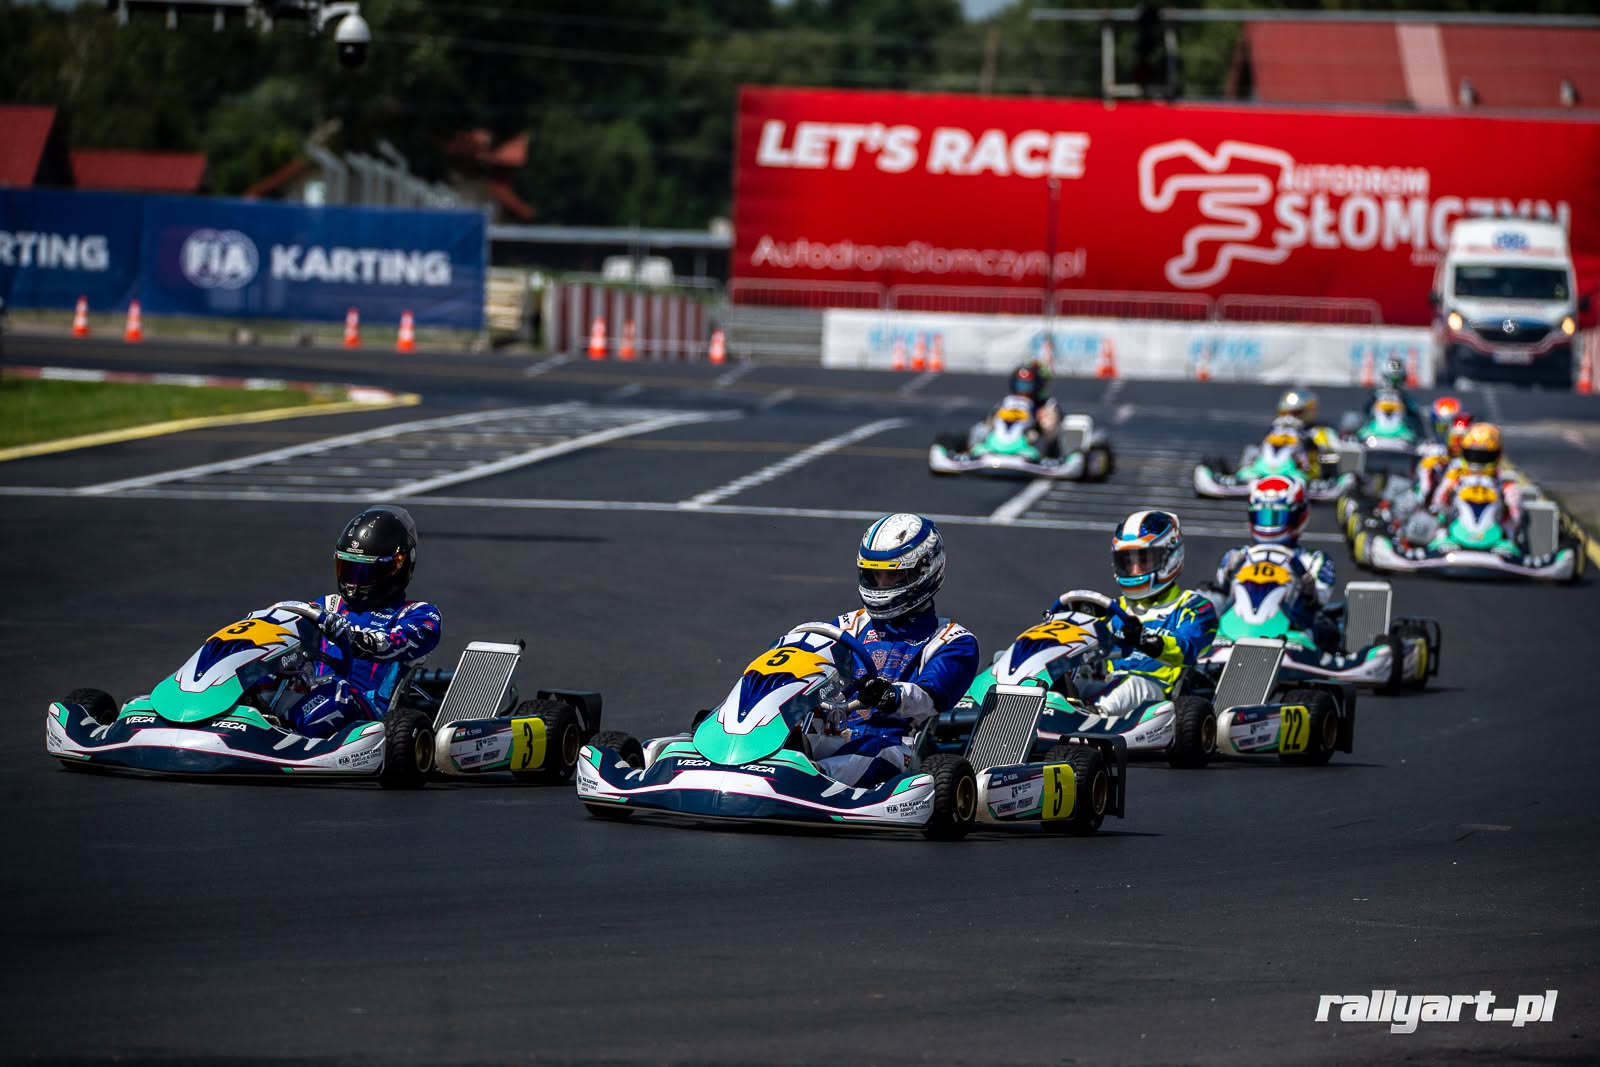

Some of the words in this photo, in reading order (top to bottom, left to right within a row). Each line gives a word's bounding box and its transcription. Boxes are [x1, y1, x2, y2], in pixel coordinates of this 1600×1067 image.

[757, 120, 922, 173] LET'S
[926, 127, 1091, 179] RACE
[1278, 164, 1430, 197] AUTODROM
[1274, 193, 1570, 251] SŁOMC
[187, 239, 251, 276] FIA
[271, 244, 452, 287] KARTING
[1253, 565, 1275, 577] 16
[226, 621, 257, 635] 3
[766, 649, 798, 667] 5
[125, 715, 156, 725] VEGA
[210, 720, 248, 733] VEGA
[1283, 708, 1303, 750] 22
[521, 721, 534, 770] 3
[676, 759, 712, 767] VEGA
[740, 763, 776, 774] VEGA
[1052, 767, 1063, 816] 5
